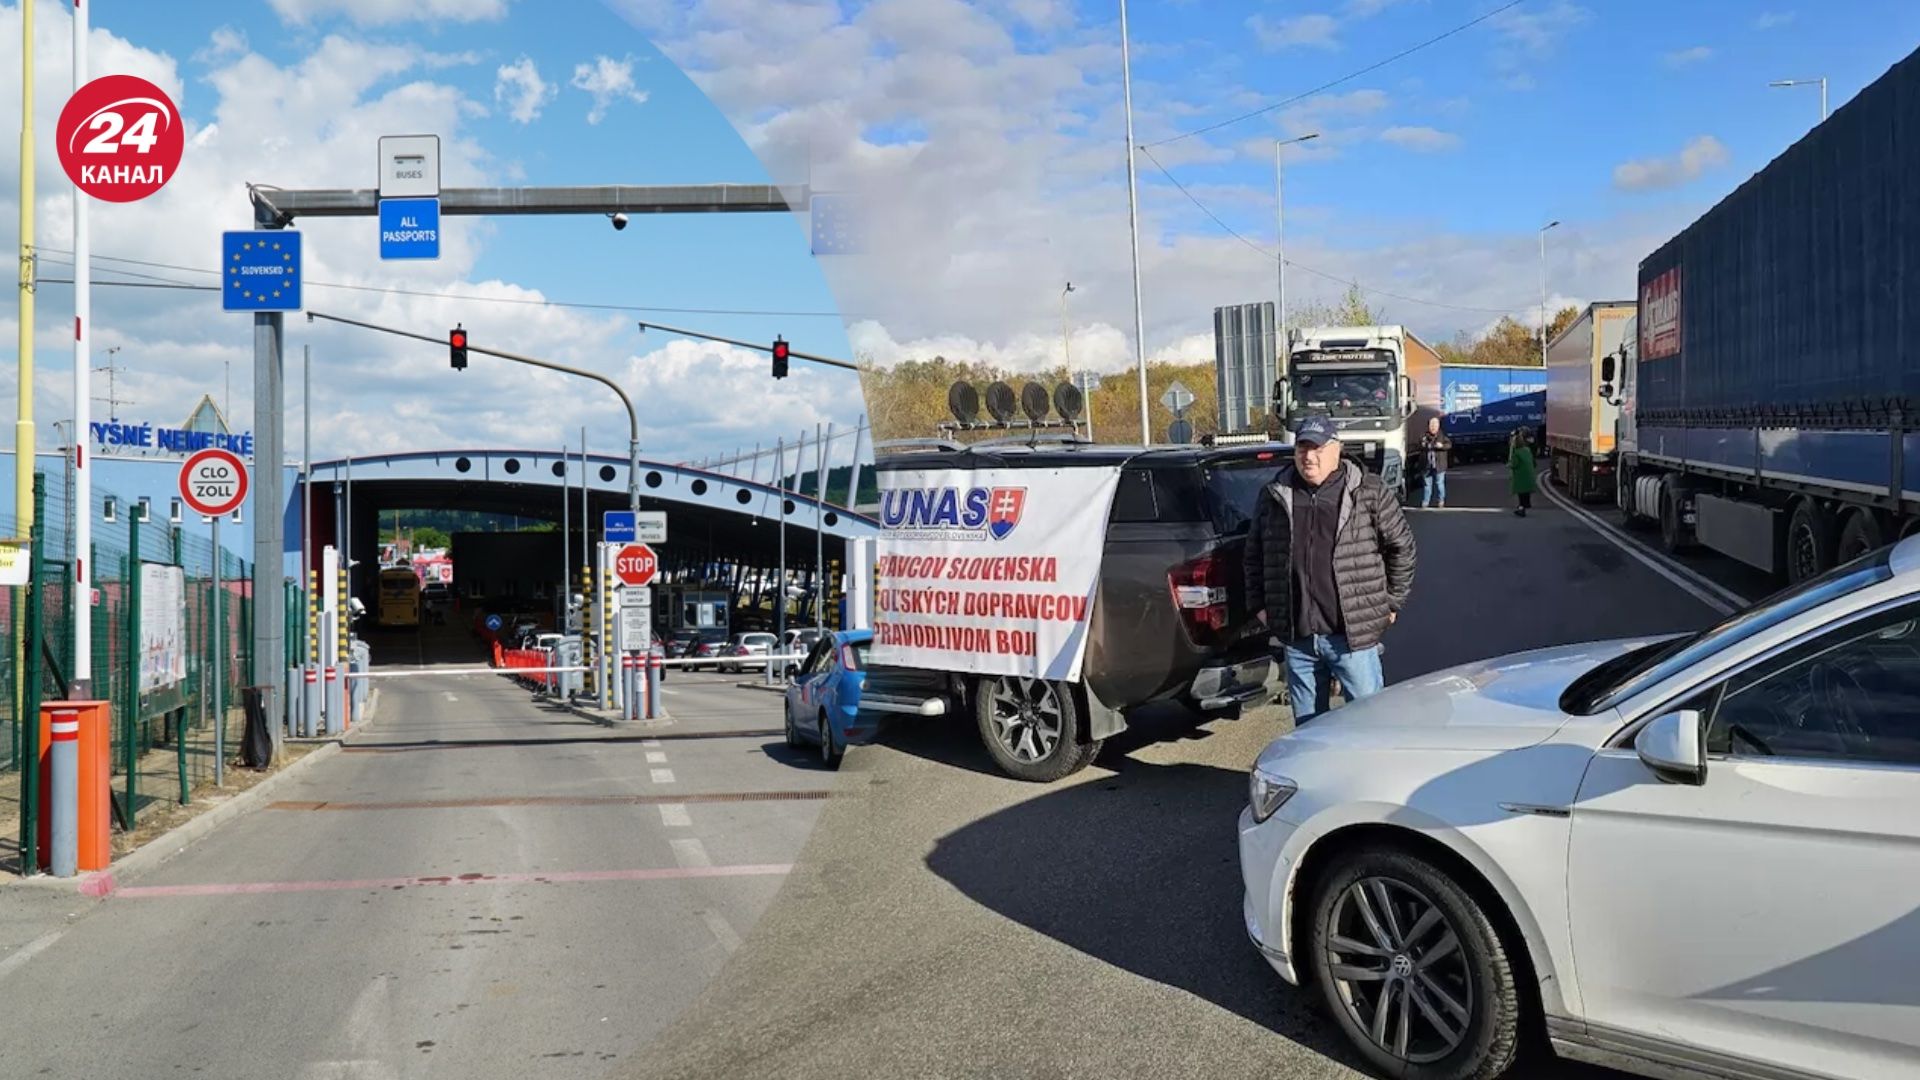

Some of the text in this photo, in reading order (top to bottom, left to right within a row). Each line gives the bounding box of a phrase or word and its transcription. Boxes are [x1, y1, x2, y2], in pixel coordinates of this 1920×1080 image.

[396, 170, 423, 179] BUSES
[401, 216, 418, 227] ALL
[383, 230, 436, 242] PASSPORTS
[241, 266, 284, 275] SLOVENSKO
[158, 429, 253, 455] NEMECKÉ
[200, 467, 228, 478] CLO
[196, 486, 232, 497] ZOLL
[882, 487, 989, 528] UNAS
[618, 557, 653, 573] STOP
[948, 557, 1056, 582] SLOVENSKA
[964, 592, 1087, 621] DOPRAVCOV
[996, 630, 1036, 656] BOJI
